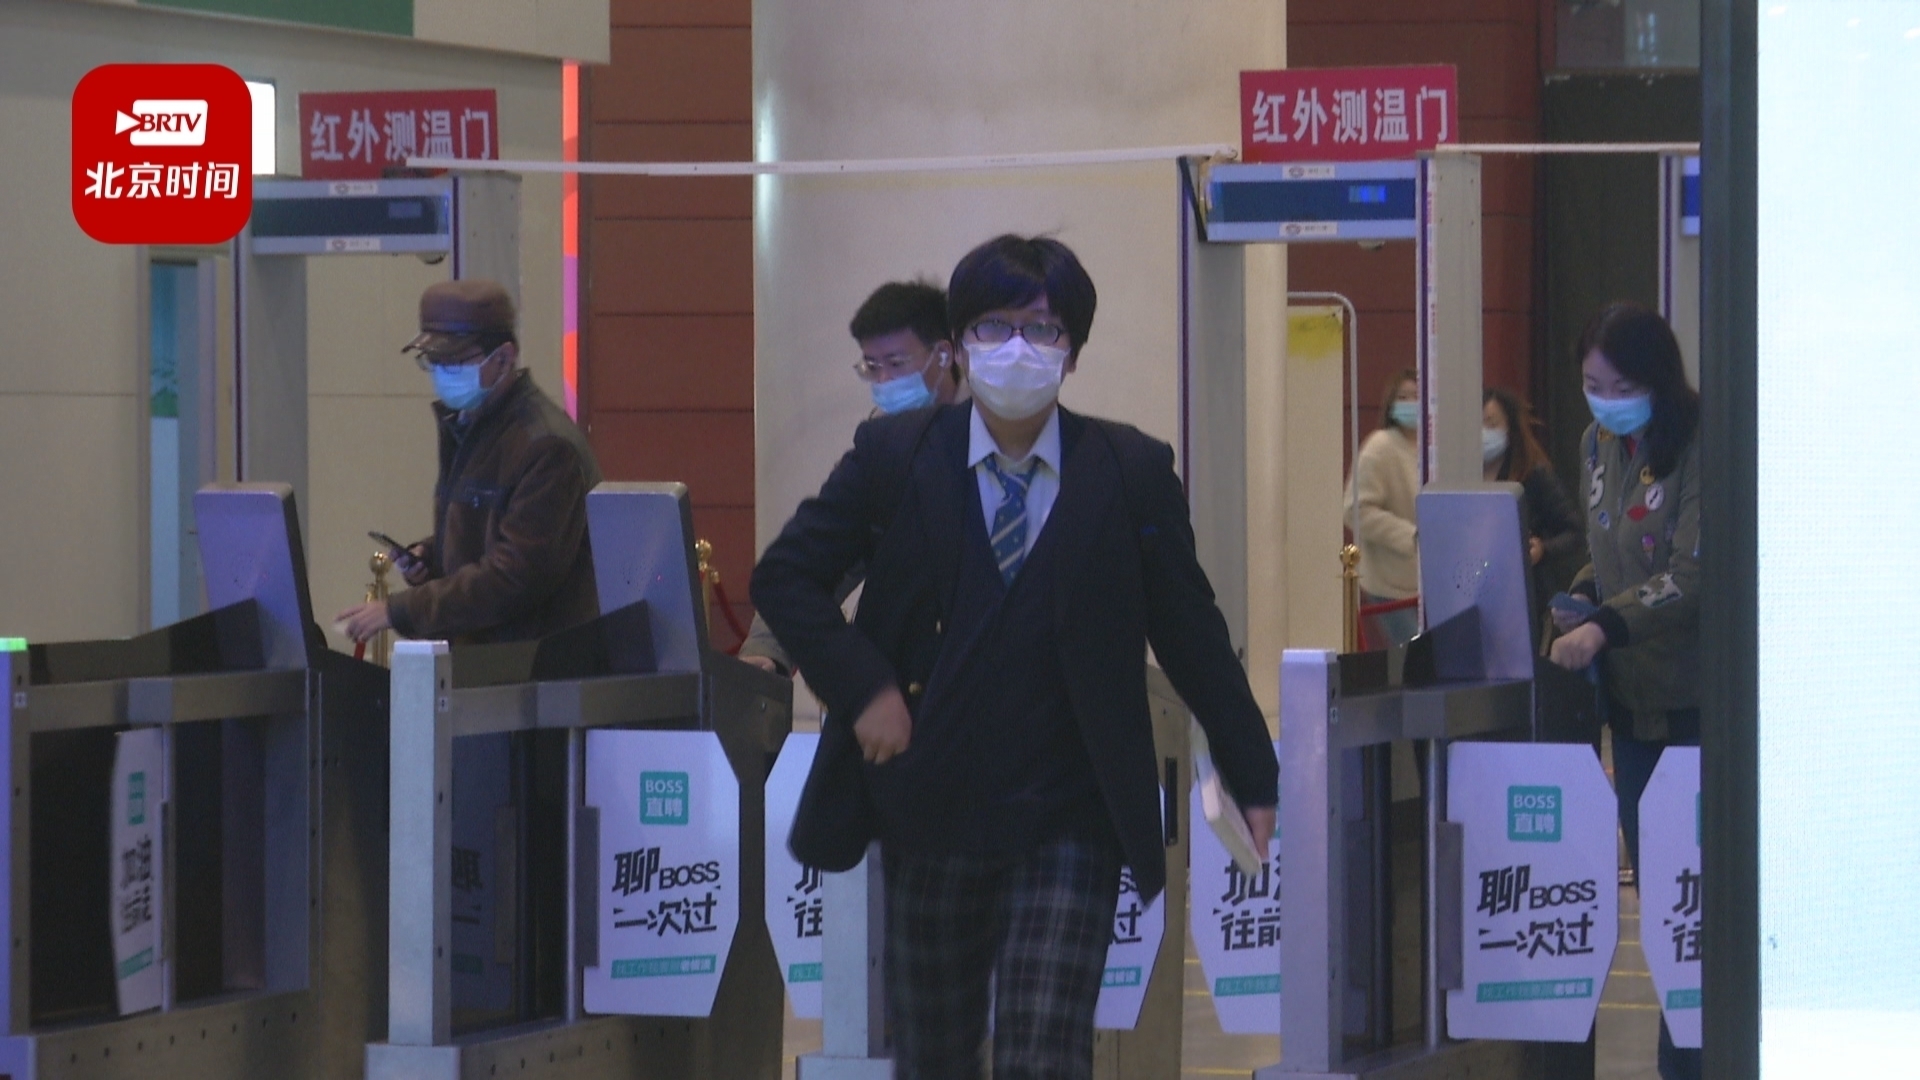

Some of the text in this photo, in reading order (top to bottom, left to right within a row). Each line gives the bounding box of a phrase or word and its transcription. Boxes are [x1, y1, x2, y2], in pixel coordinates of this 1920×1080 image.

[1252, 86, 1449, 146] 红外测温门
[310, 108, 491, 162] 红外测温门
[645, 779, 683, 794] BOSS
[1513, 794, 1555, 809] BOSS
[645, 797, 683, 818] 直聘
[1513, 812, 1555, 834] 直聘
[614, 892, 718, 937] 一次过
[1479, 912, 1594, 959] 一次过
